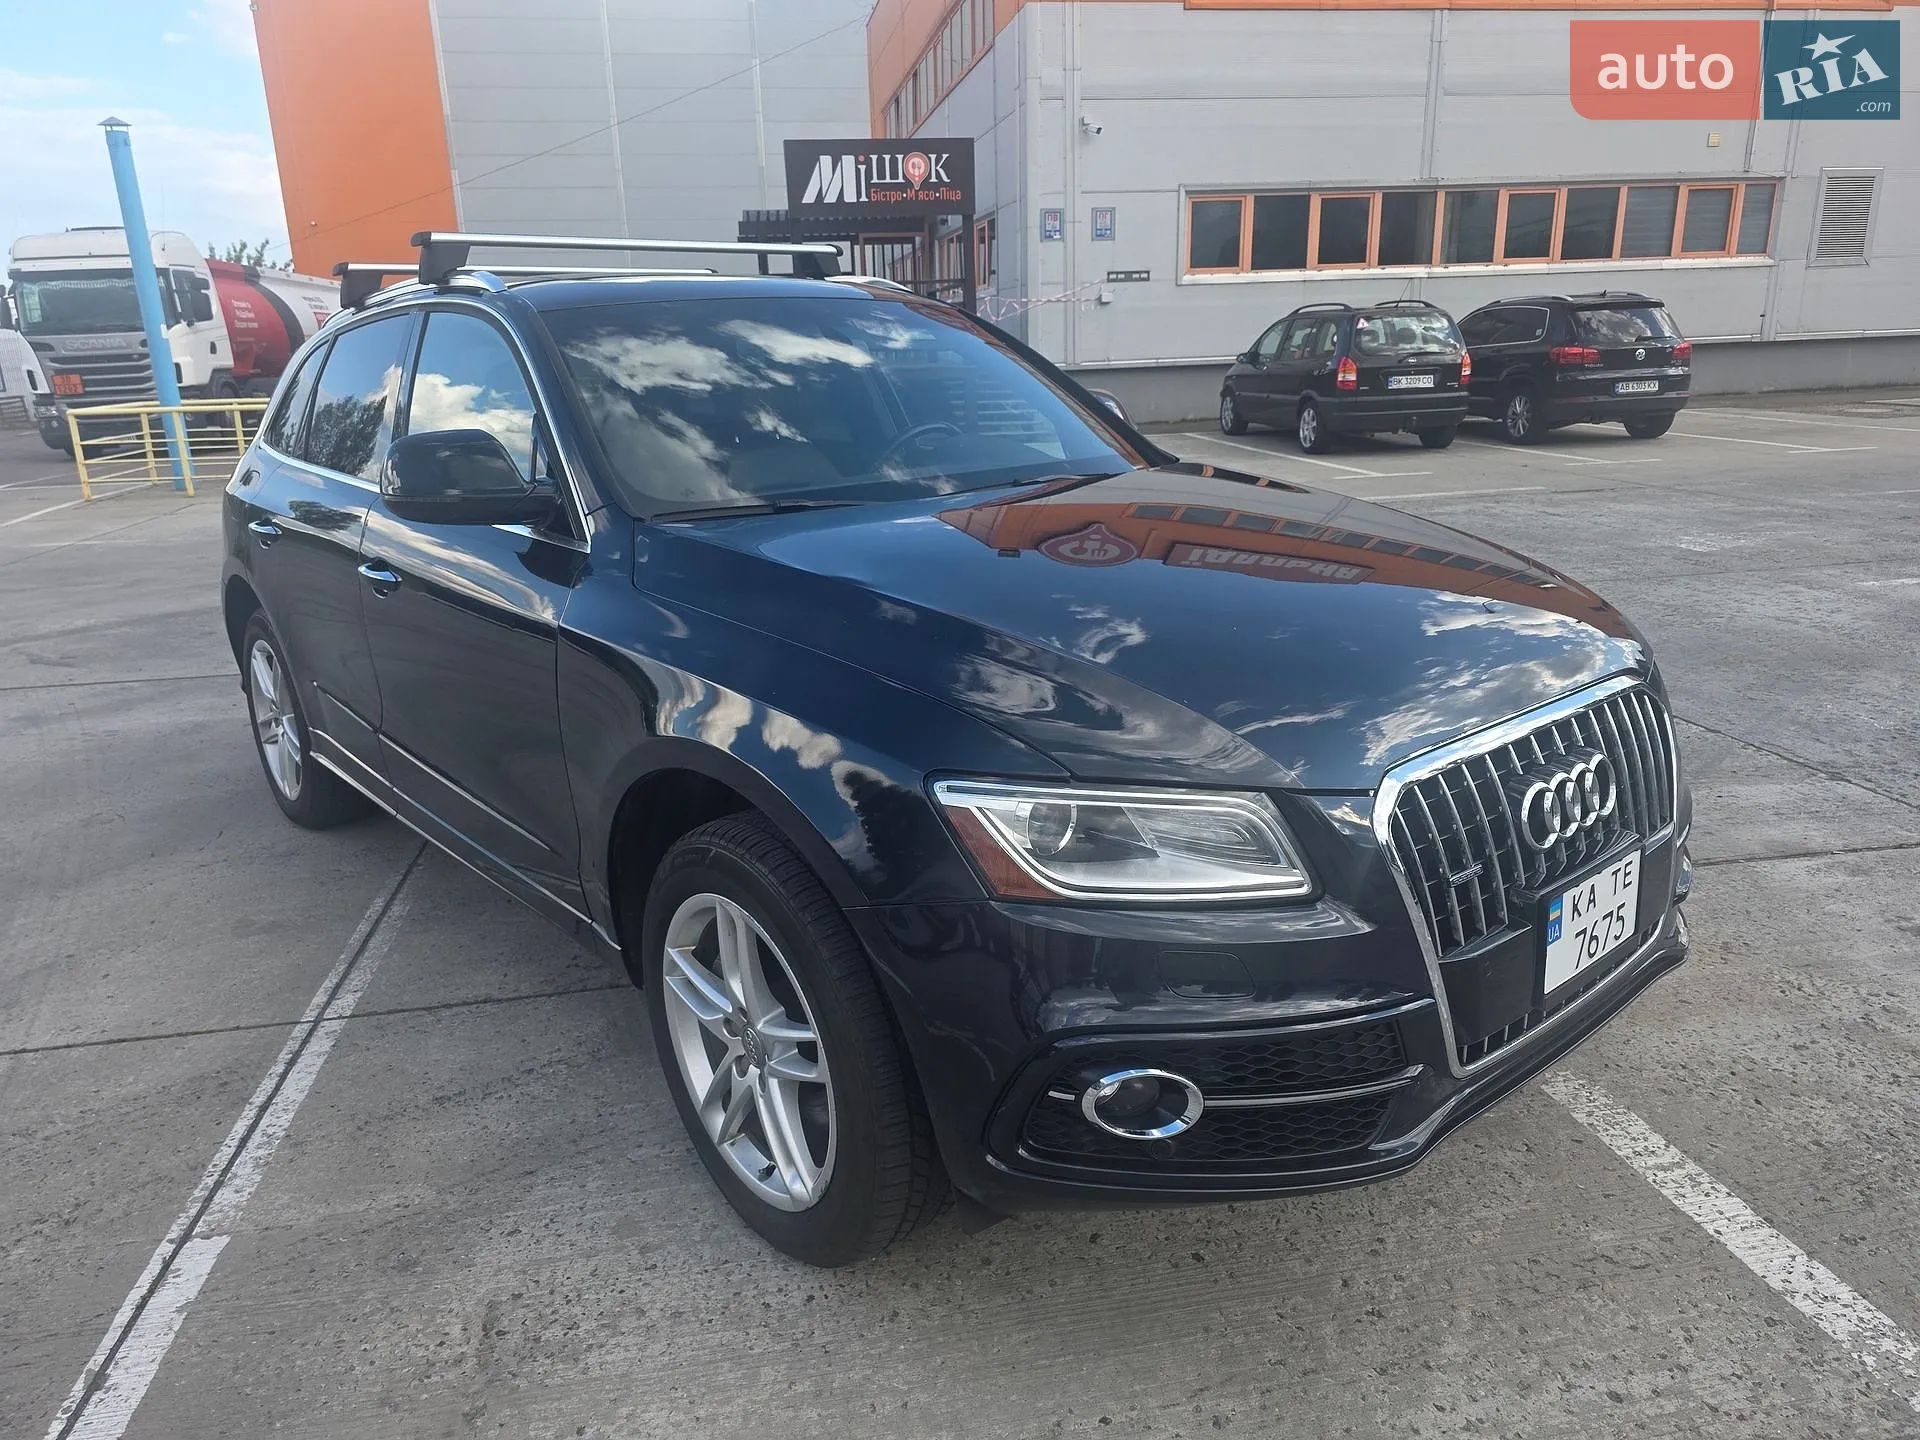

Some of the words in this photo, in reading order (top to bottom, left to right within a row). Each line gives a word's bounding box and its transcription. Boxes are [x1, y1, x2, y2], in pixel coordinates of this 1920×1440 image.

[871, 188, 902, 204] Бістро
[940, 187, 962, 202] Піца
[65, 338, 127, 350] SCANIA
[1571, 883, 1597, 922] KA
[1612, 860, 1634, 897] TE
[1548, 923, 1560, 943] UA
[1575, 902, 1627, 970] 7675
